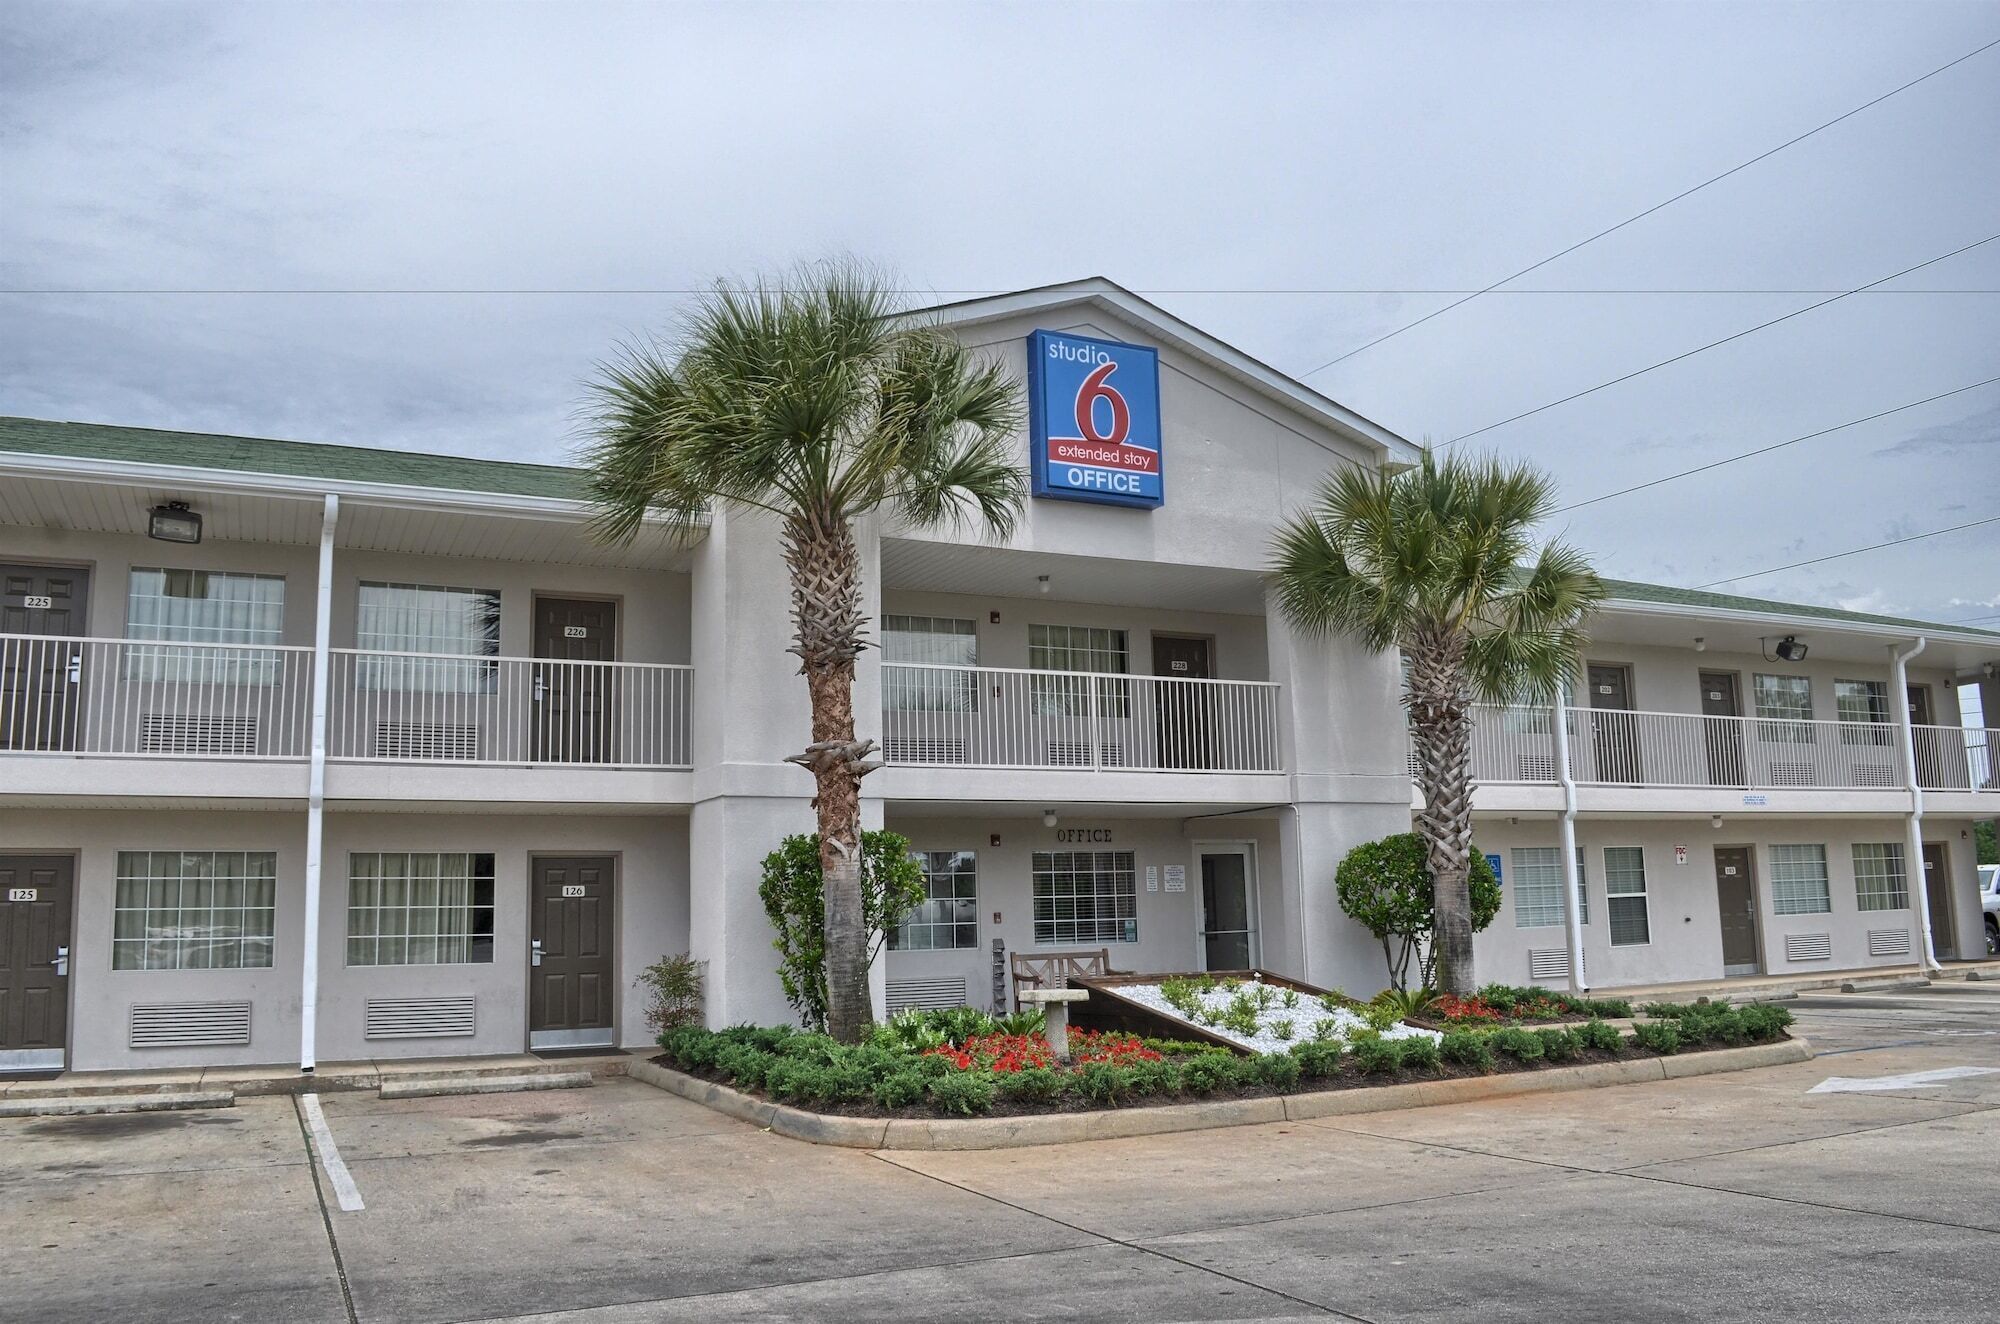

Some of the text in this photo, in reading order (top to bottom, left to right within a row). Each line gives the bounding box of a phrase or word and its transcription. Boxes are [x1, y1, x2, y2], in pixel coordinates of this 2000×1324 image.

[1049, 341, 1110, 365] studio
[1074, 361, 1131, 445] 6
[1057, 445, 1151, 469] extended stay
[1067, 467, 1141, 493] OFFICE
[27, 597, 49, 607] 225
[567, 627, 585, 637] 226
[1057, 829, 1112, 843] OFFICE
[13, 890, 34, 900] 125
[566, 887, 583, 896] 126
